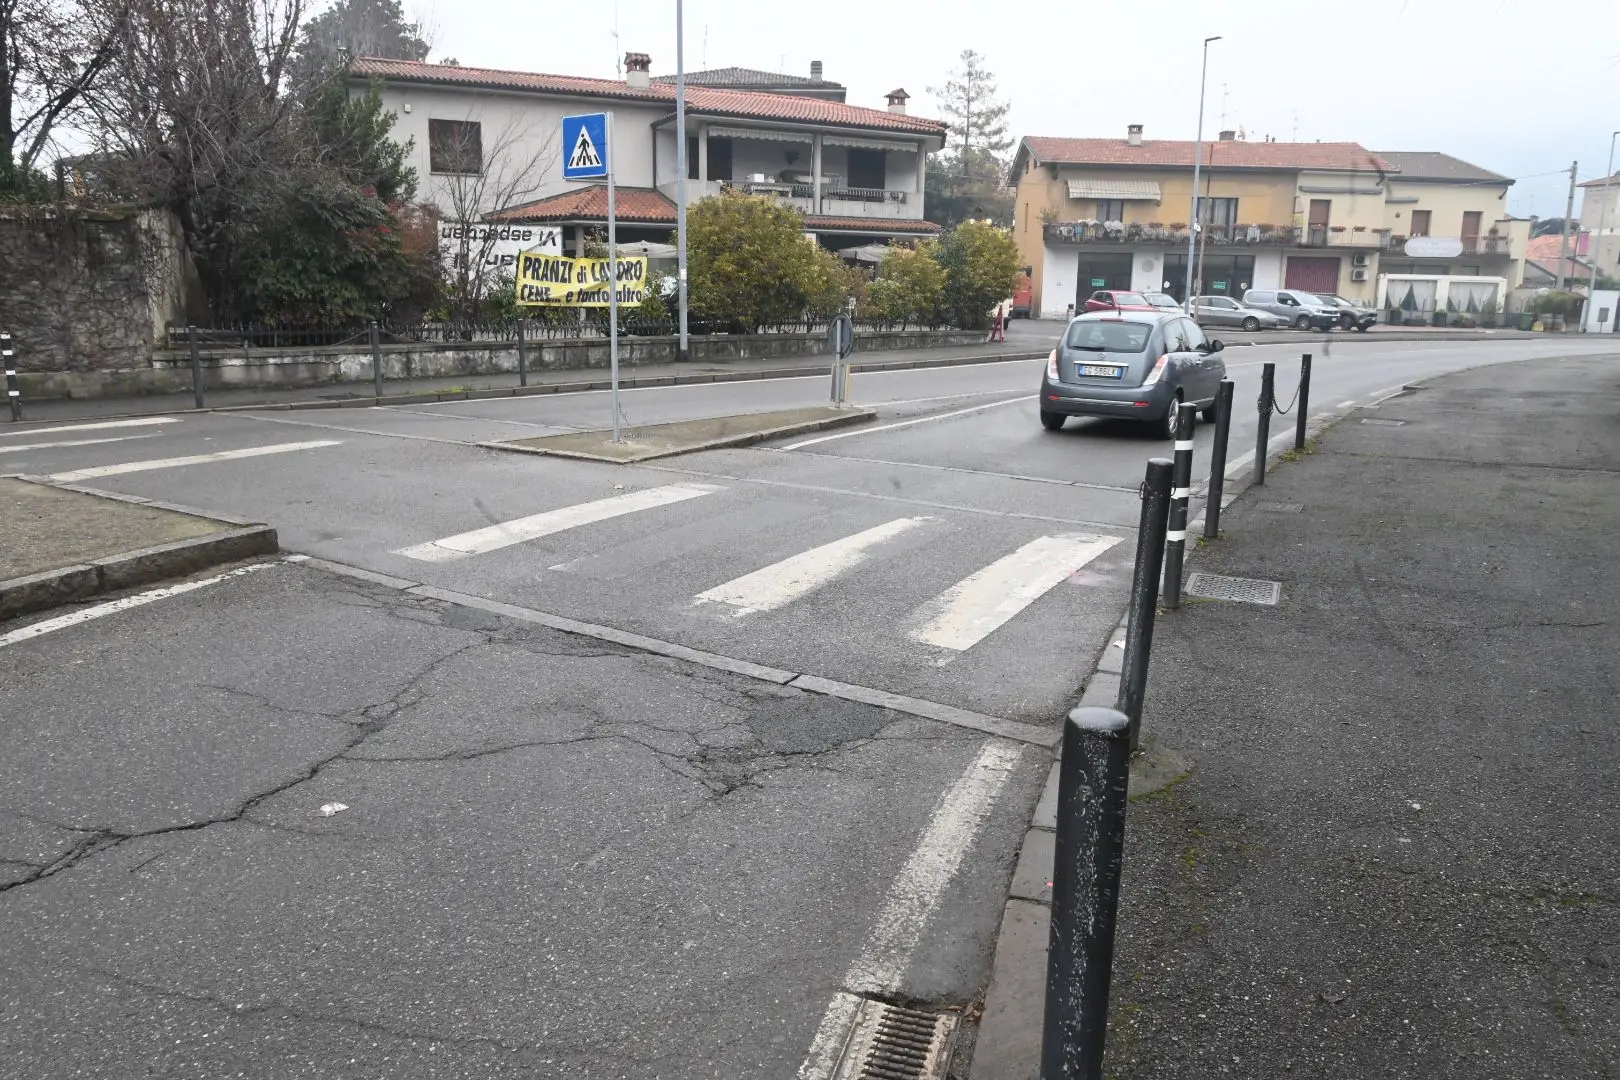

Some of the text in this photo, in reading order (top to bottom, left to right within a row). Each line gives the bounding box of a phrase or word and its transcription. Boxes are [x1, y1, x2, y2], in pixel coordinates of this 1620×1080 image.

[522, 256, 574, 284] PRANZI
[576, 265, 587, 284] di
[565, 290, 573, 303] e
[576, 288, 610, 303] tanto
[616, 284, 642, 303] altro
